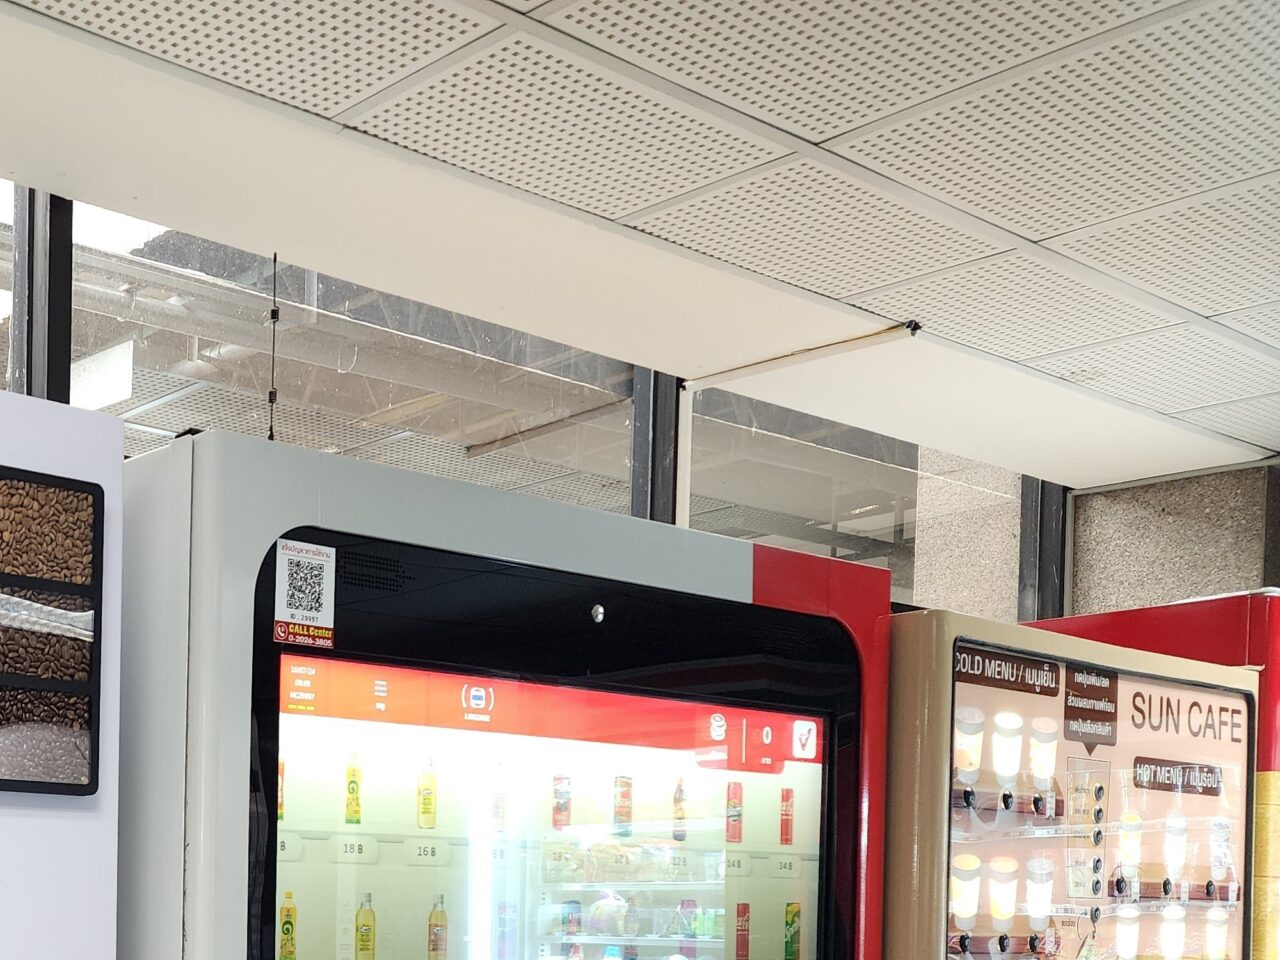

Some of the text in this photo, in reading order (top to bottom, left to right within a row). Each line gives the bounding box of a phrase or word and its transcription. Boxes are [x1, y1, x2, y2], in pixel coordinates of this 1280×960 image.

[289, 624, 333, 637] CALL Center
[985, 659, 1016, 681] MENU
[1025, 664, 1055, 692] เมนูเย็น
[1131, 691, 1242, 743] SUN CAFE
[763, 726, 772, 745] 0
[1137, 763, 1156, 781] HOT
[1156, 765, 1182, 785] MENU
[343, 843, 355, 853] 18
[417, 846, 429, 856] 16
